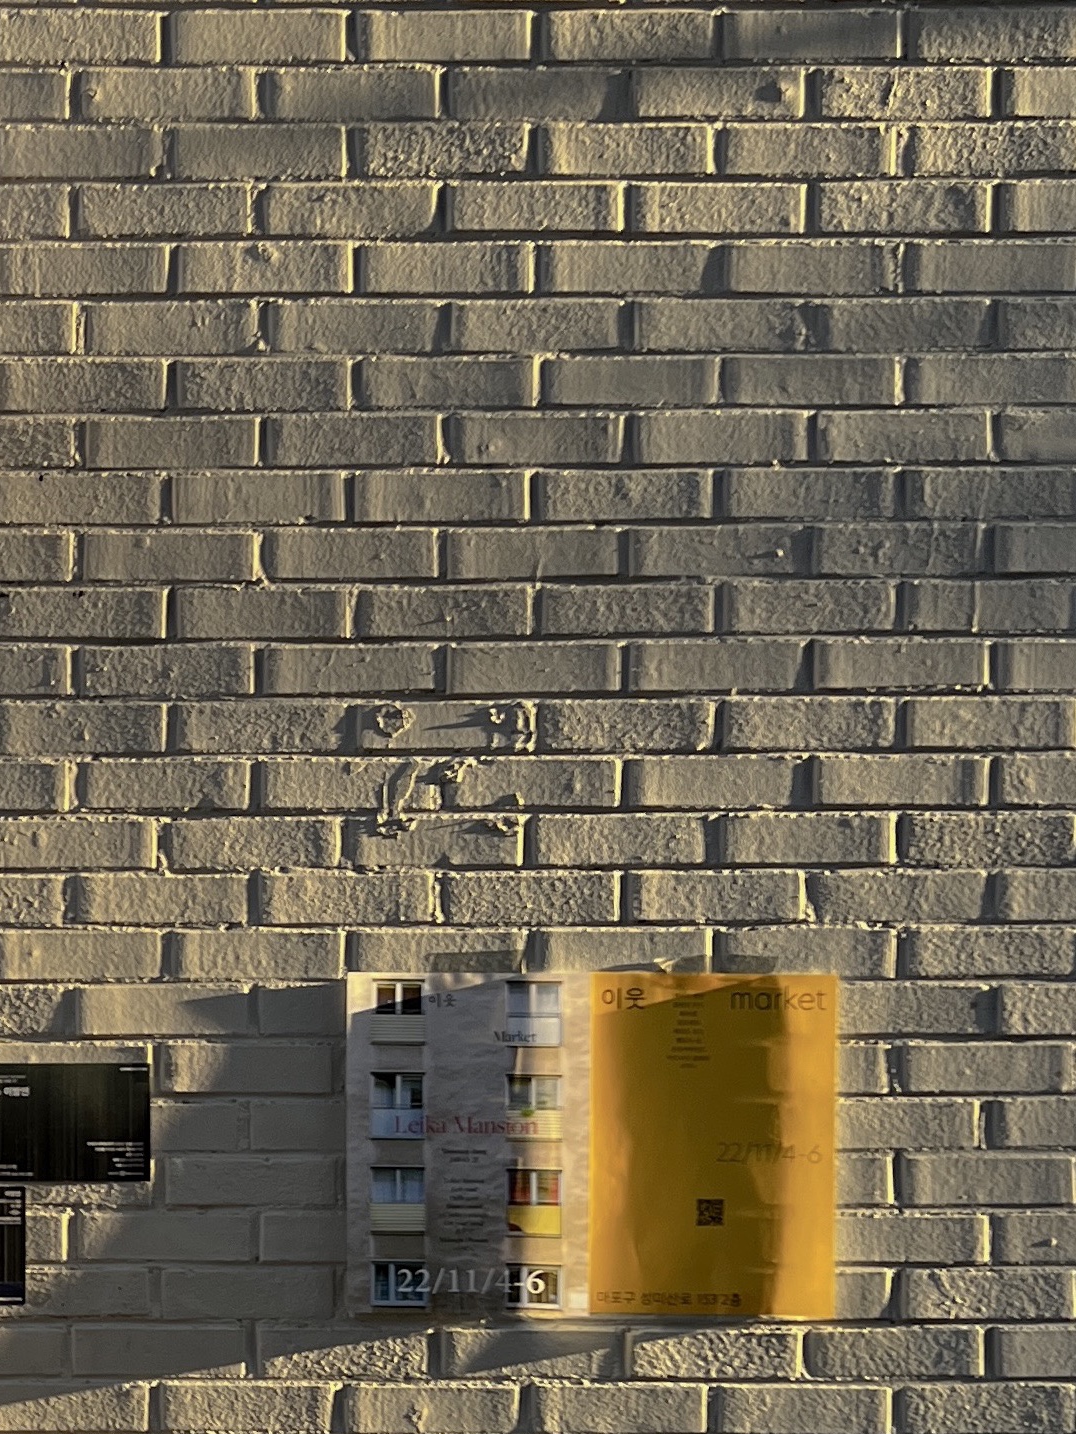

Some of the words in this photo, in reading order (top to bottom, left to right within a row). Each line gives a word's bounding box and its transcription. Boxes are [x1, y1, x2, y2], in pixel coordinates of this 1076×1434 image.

[428, 993, 457, 1008] 이웃
[601, 987, 646, 1010] 이웃
[730, 986, 828, 1011] market
[493, 1030, 538, 1043] Market
[454, 1115, 540, 1135] Mansion
[715, 1141, 823, 1165] 22/11/4-6
[396, 1267, 547, 1295] 22/11/4-6
[596, 1291, 636, 1304] 마포구
